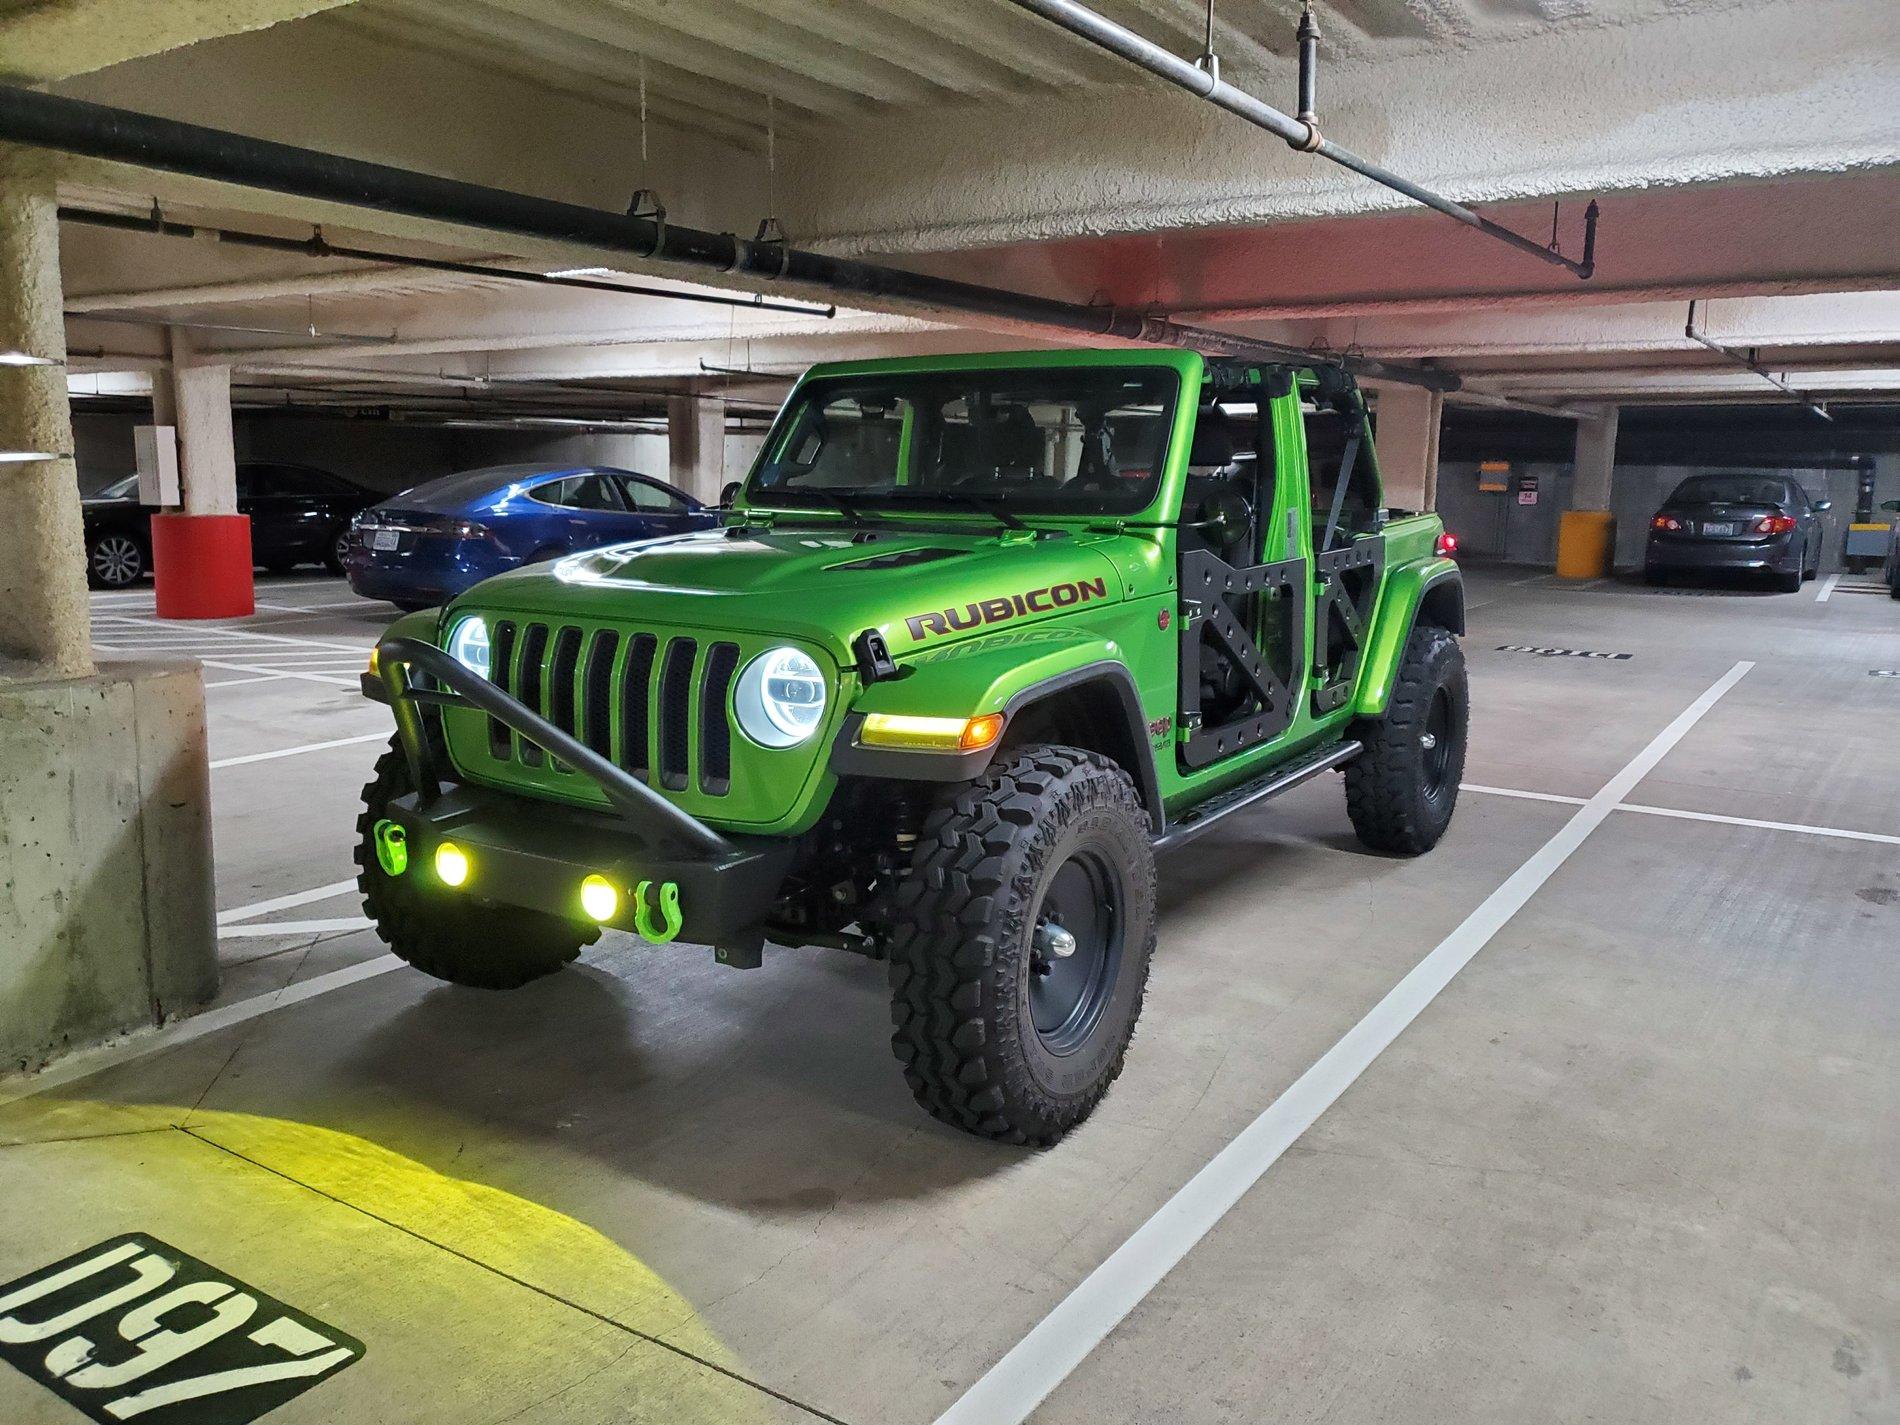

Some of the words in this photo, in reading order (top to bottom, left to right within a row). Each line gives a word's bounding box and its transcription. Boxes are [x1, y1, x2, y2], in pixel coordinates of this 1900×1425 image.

[906, 578, 1107, 641] RUBICON
[1148, 716, 1171, 738] eep
[0, 1242, 356, 1420] 097
